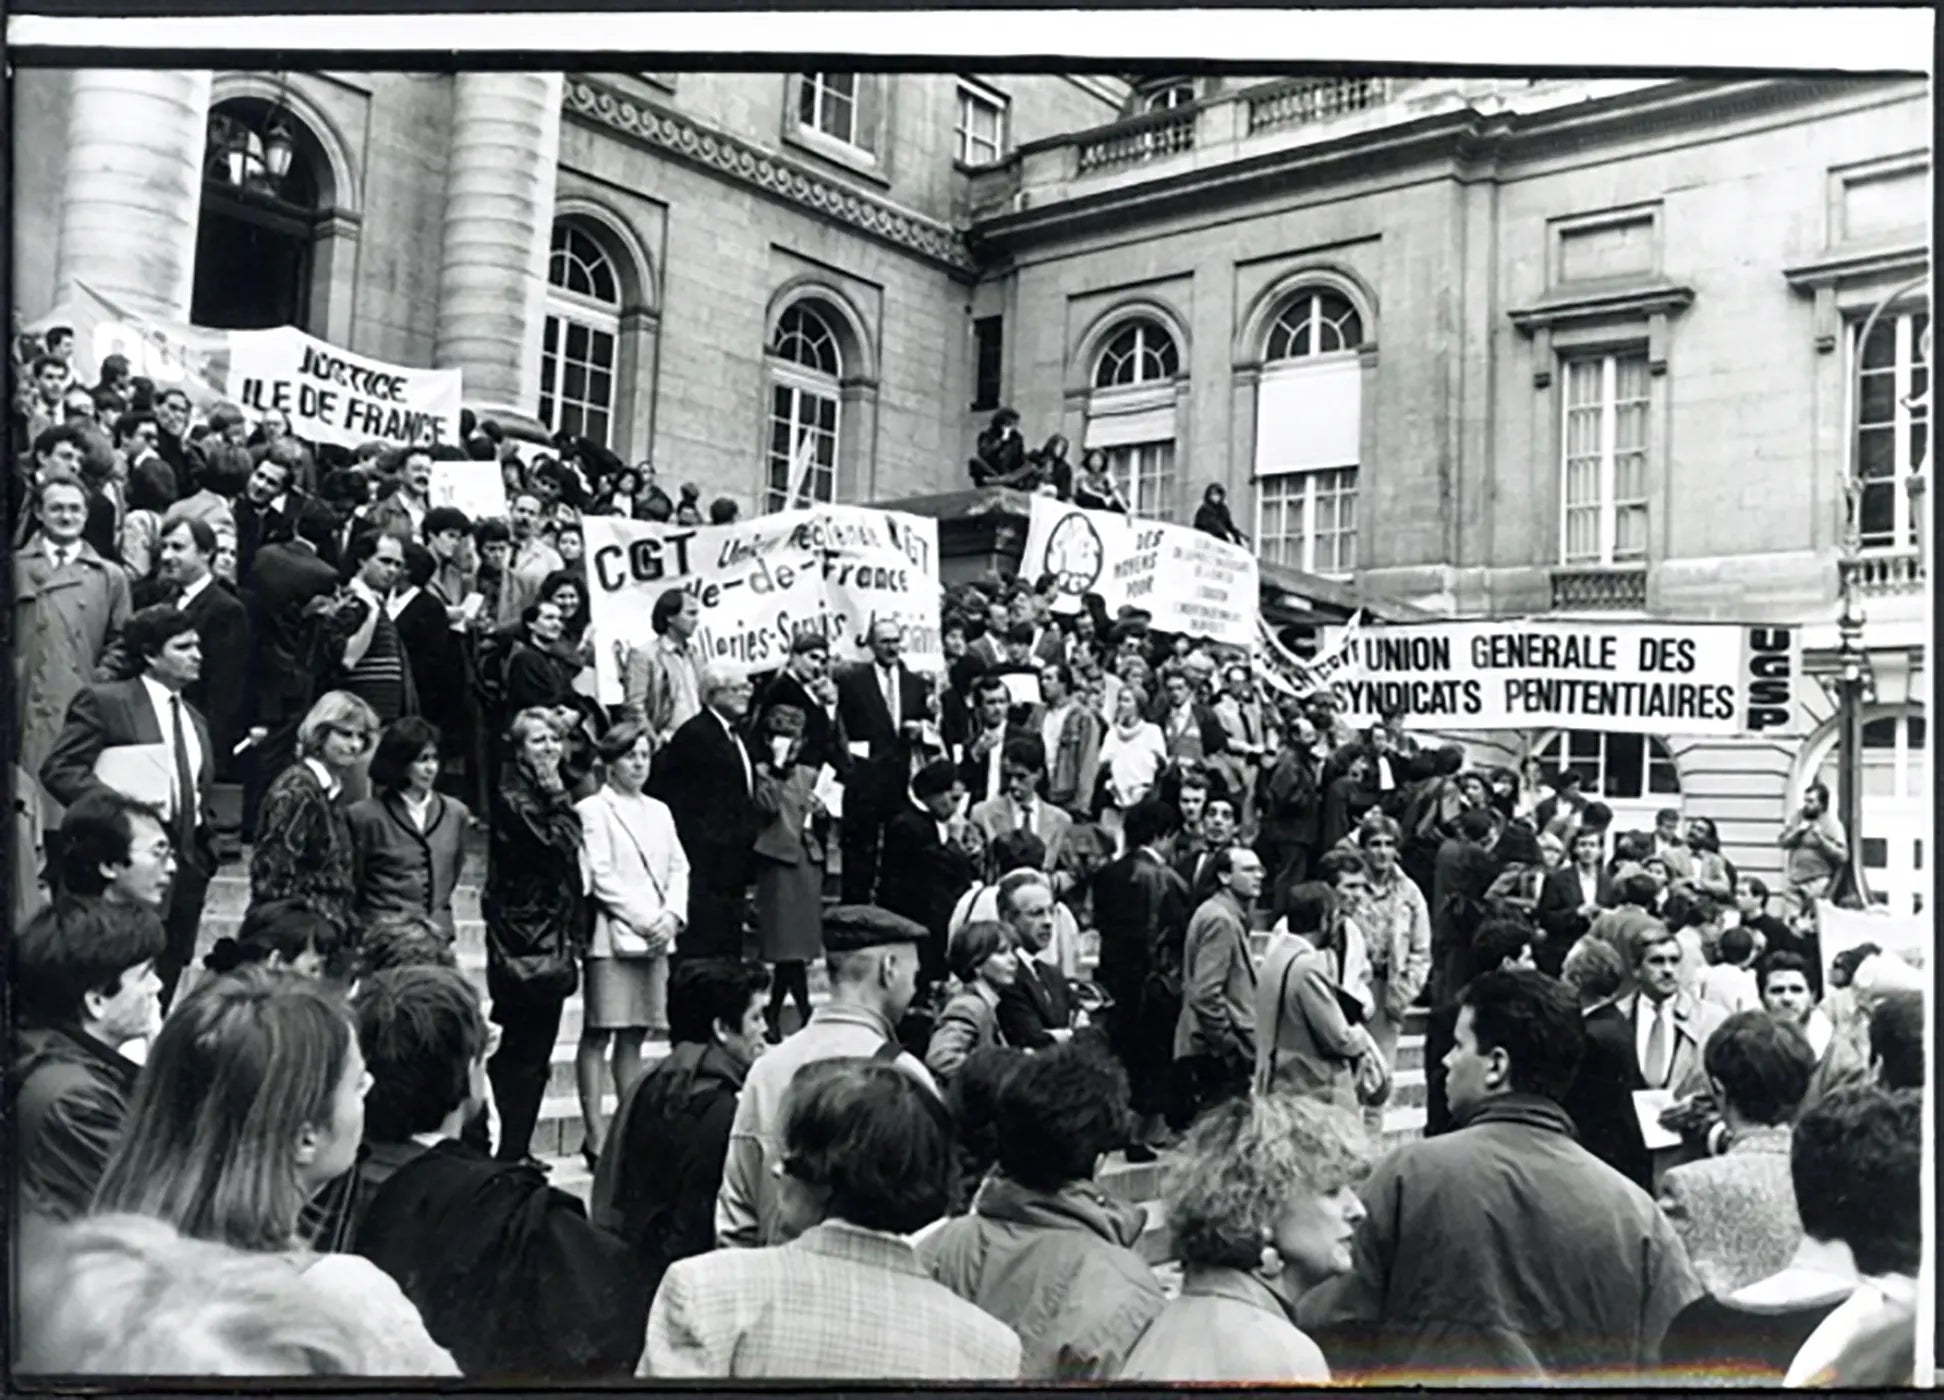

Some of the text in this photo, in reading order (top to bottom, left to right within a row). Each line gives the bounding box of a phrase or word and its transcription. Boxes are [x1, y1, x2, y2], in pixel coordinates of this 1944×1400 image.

[298, 345, 408, 403] JUSTICE
[242, 378, 448, 444] ILE DE FRANCE
[593, 530, 697, 592] CGT
[1364, 633, 1697, 674] UNION GENERALE DES
[1746, 628, 1792, 732] UGSP
[1331, 678, 1735, 721] SYNDICATS PENITENTIAIRES
